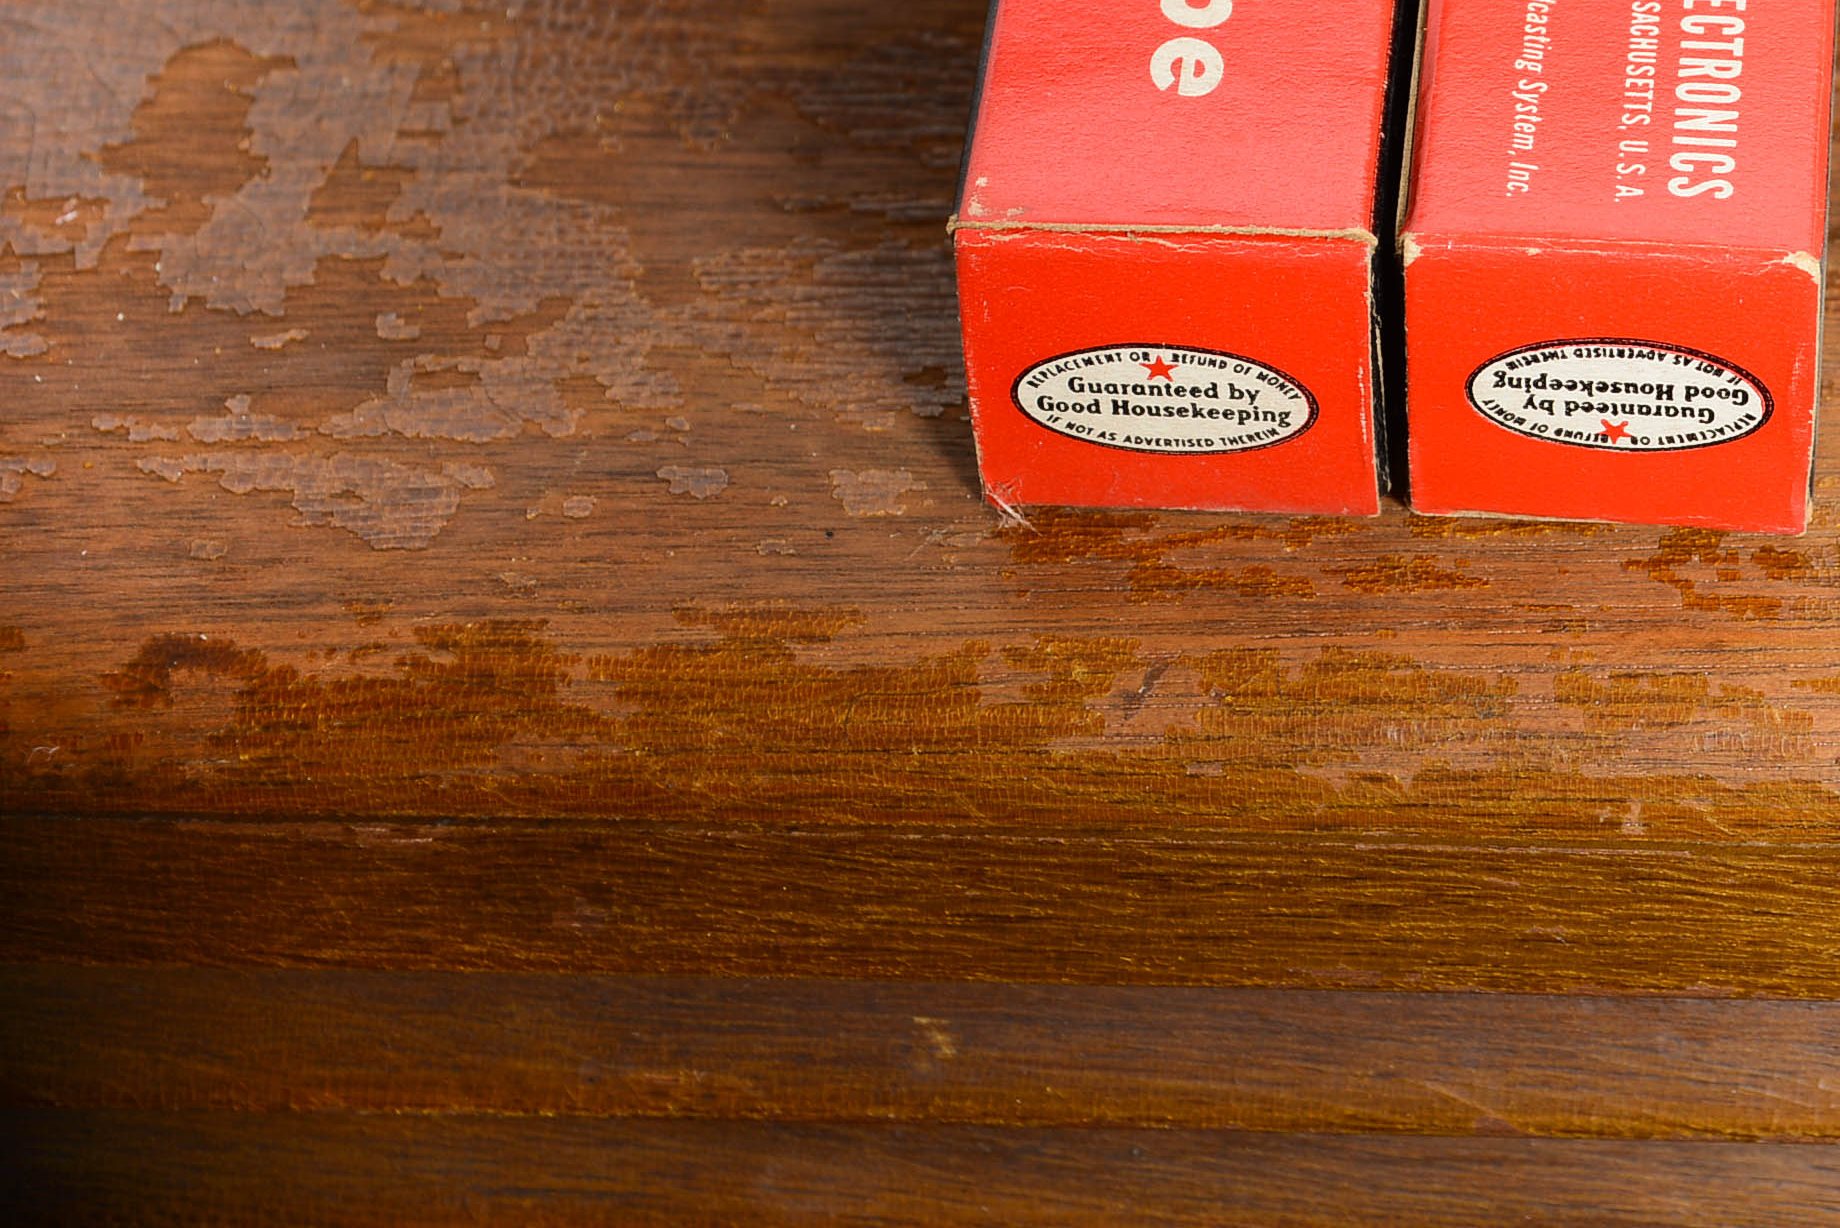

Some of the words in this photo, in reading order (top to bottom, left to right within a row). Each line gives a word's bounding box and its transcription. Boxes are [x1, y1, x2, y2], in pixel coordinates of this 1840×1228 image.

[1506, 78, 1549, 156] System,
[1505, 161, 1540, 197] Inc.
[1026, 352, 1123, 389] REPLACEMENT
[1129, 351, 1151, 363] OR
[1170, 352, 1228, 370] REFUND
[1233, 363, 1251, 375] OF
[1256, 371, 1303, 402] MONEY
[1067, 376, 1218, 399] Guaranteed
[1229, 383, 1261, 406] by
[1492, 370, 1674, 401] Housekeeping
[1036, 395, 1101, 415] Good
[1111, 400, 1291, 428] Housekeeping
[1523, 394, 1554, 415] by
[1565, 399, 1716, 424] Guaranteed
[1685, 385, 1749, 407] Good
[1047, 415, 1060, 426] IF
[1066, 422, 1093, 435] NOT
[1097, 431, 1116, 441] AS
[1124, 435, 1215, 448] ADVERTISED
[1219, 427, 1280, 447] THEREIN
